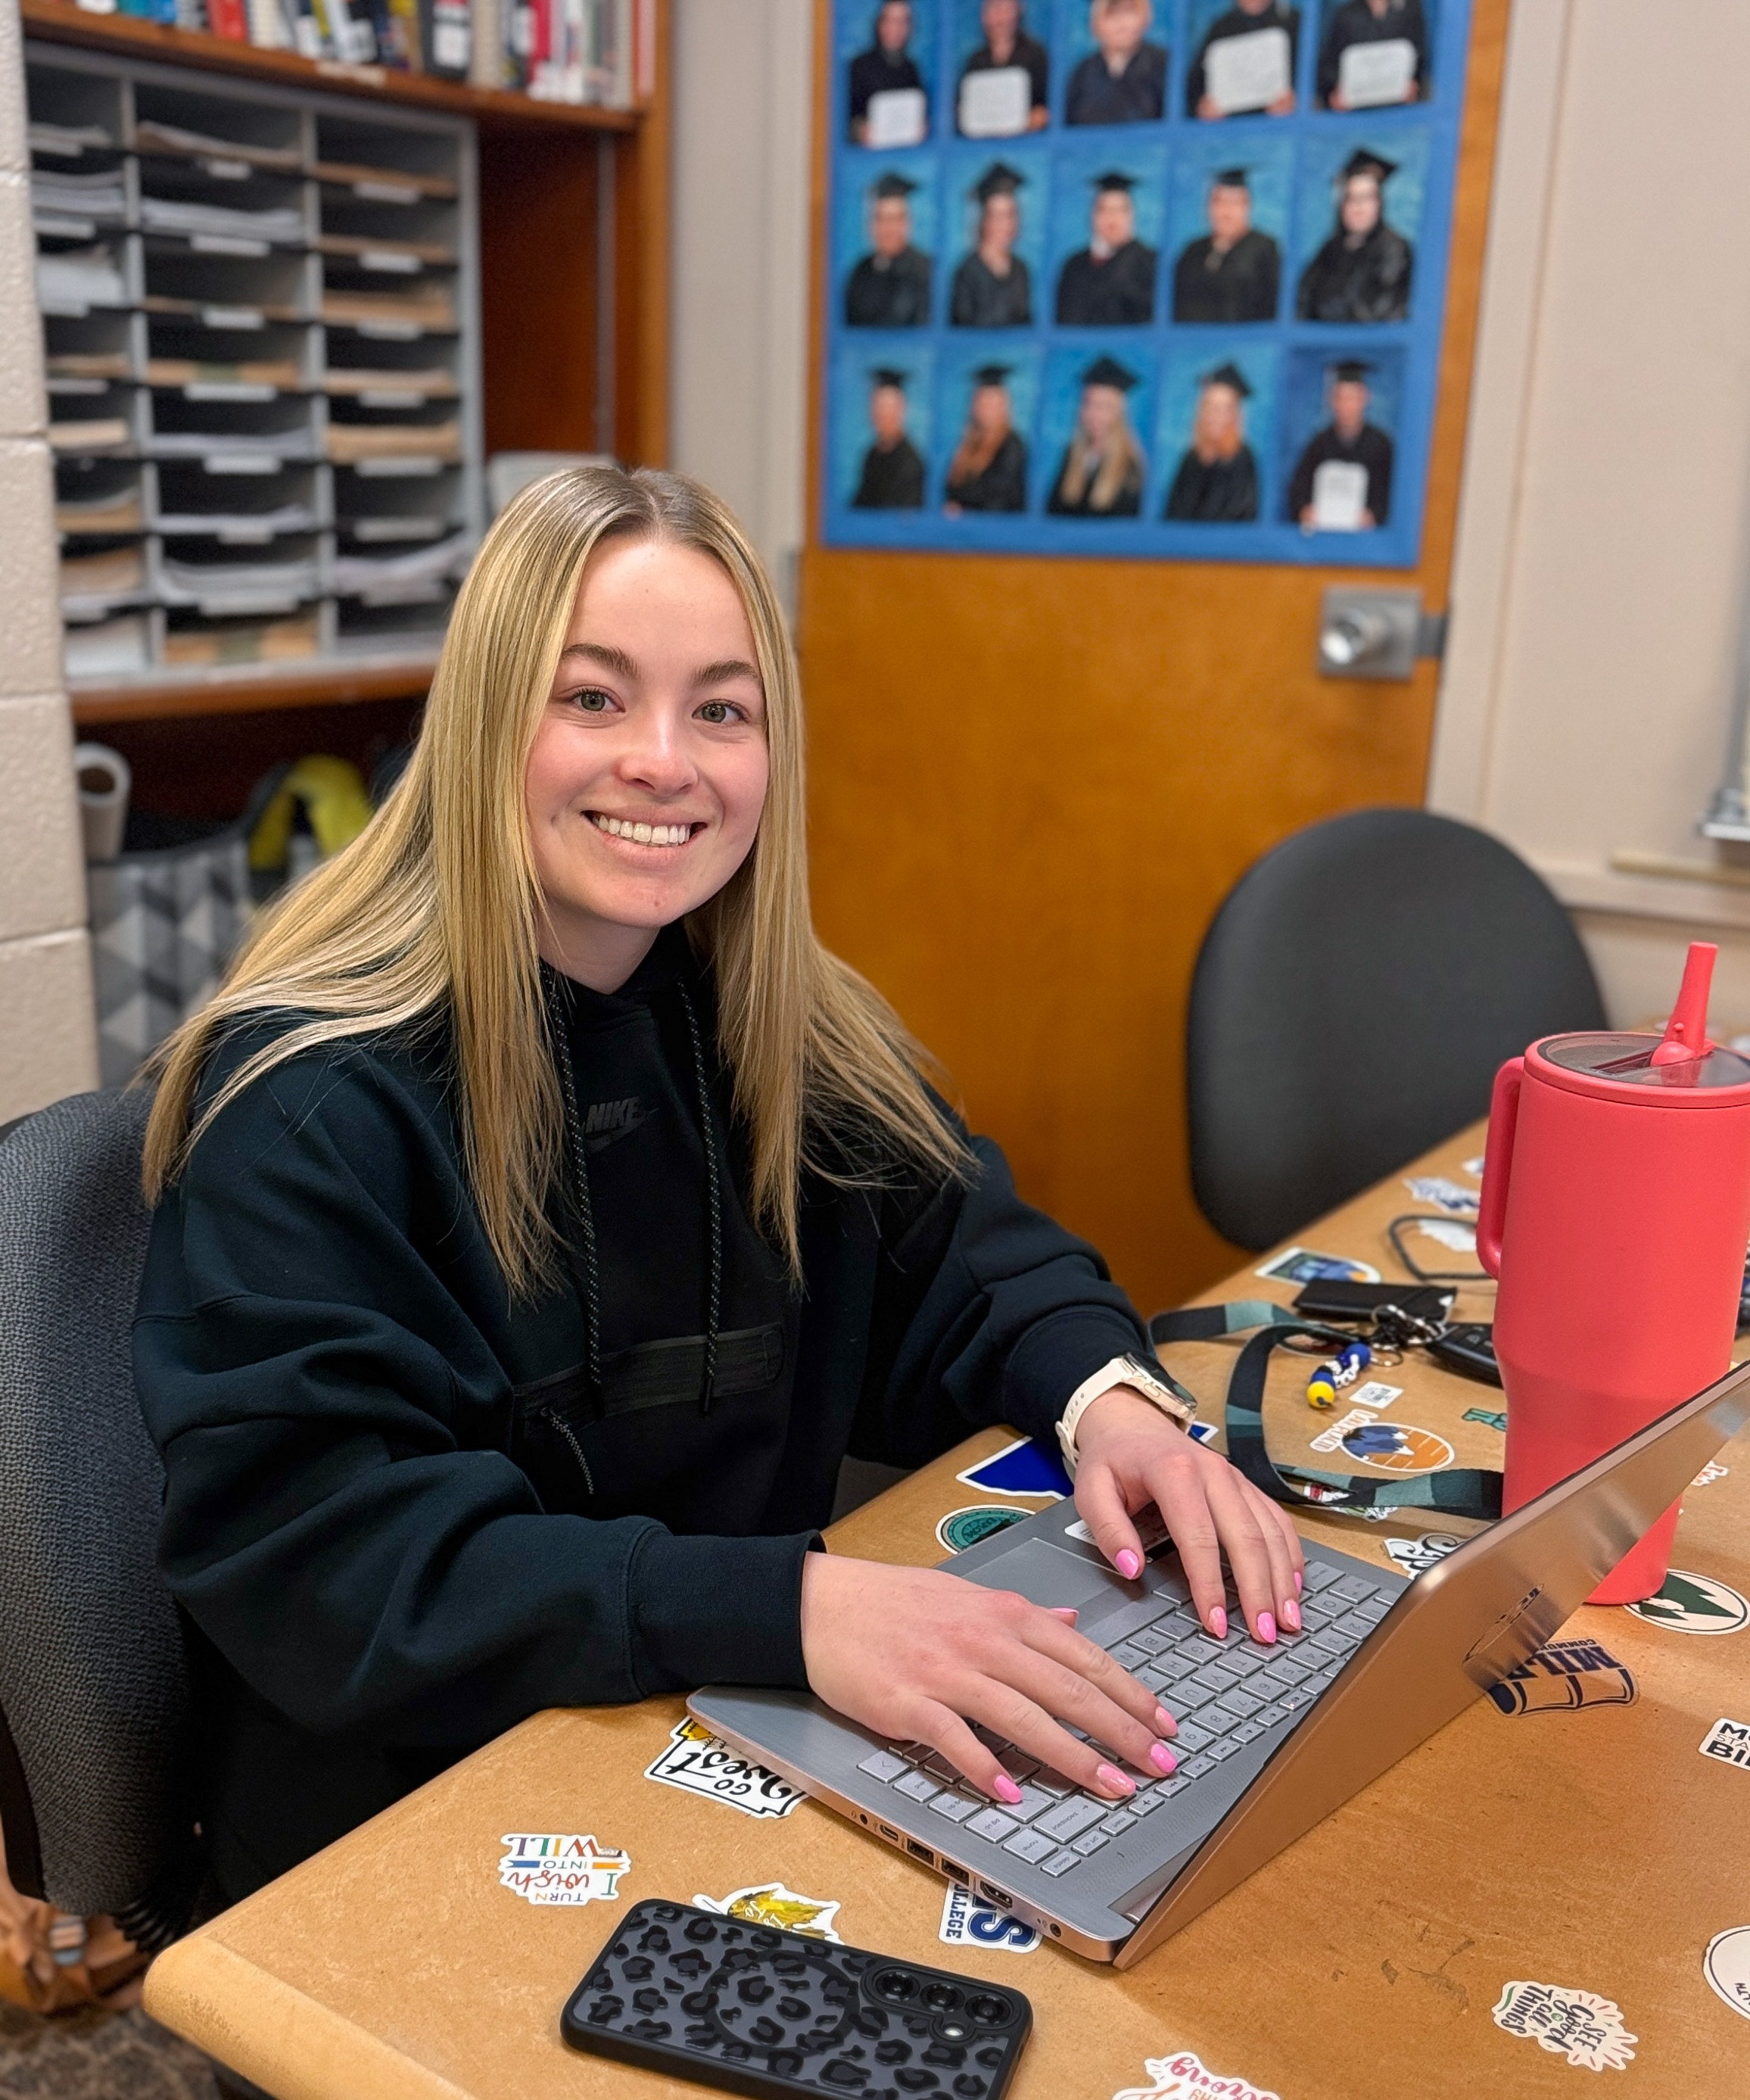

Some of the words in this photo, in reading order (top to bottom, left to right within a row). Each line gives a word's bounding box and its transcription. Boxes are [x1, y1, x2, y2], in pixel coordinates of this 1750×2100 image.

[585, 1097, 643, 1133] NIKE
[1719, 1722, 1750, 1740] M
[713, 1779, 752, 1796] GO
[507, 1837, 599, 1858] WILL
[543, 1860, 587, 1869] INTO
[506, 1869, 590, 1893] wish
[600, 1873, 618, 1896] I
[534, 1893, 584, 1902] TURN
[1500, 1985, 1555, 2034] THINGS
[1528, 2003, 1552, 2029] all
[1573, 2022, 1607, 2052] SEE
